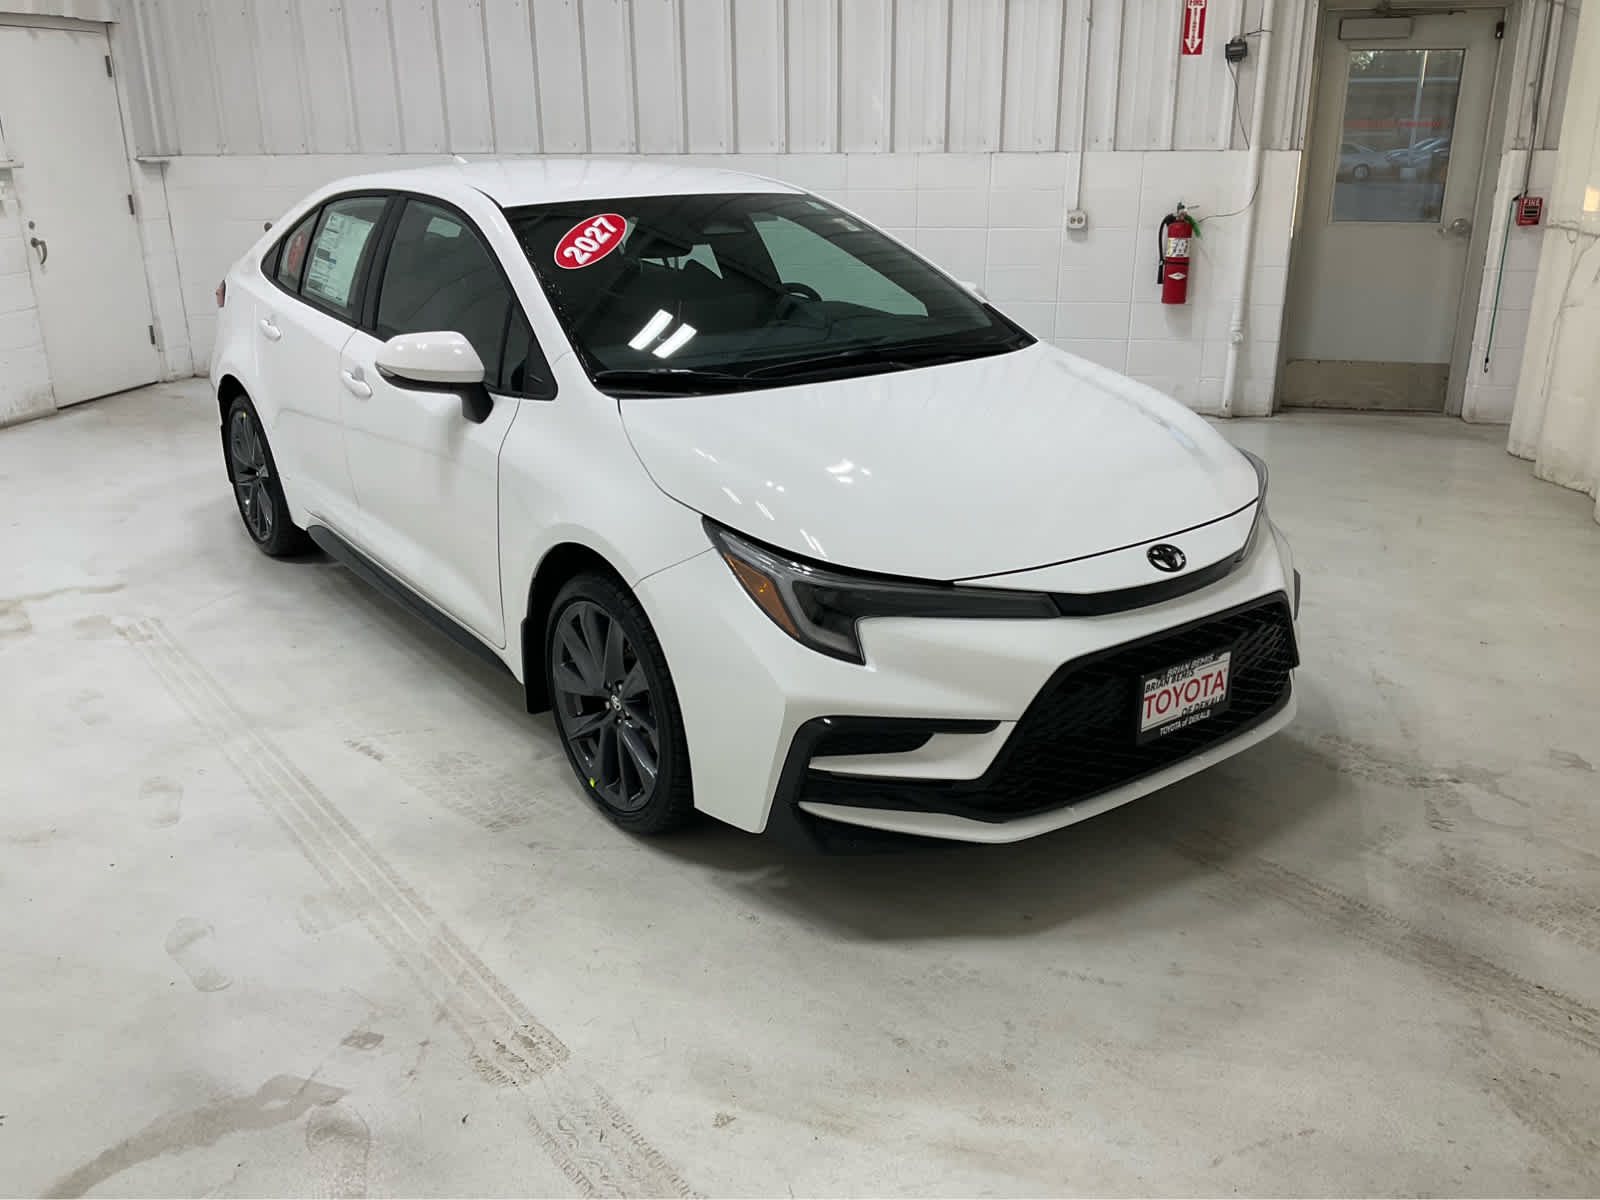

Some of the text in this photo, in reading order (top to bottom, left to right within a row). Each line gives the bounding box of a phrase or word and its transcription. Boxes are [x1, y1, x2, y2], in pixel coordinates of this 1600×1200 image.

[563, 217, 617, 264] 2027
[1143, 670, 1224, 719] TOYOTA
[1146, 679, 1170, 693] BRIAN
